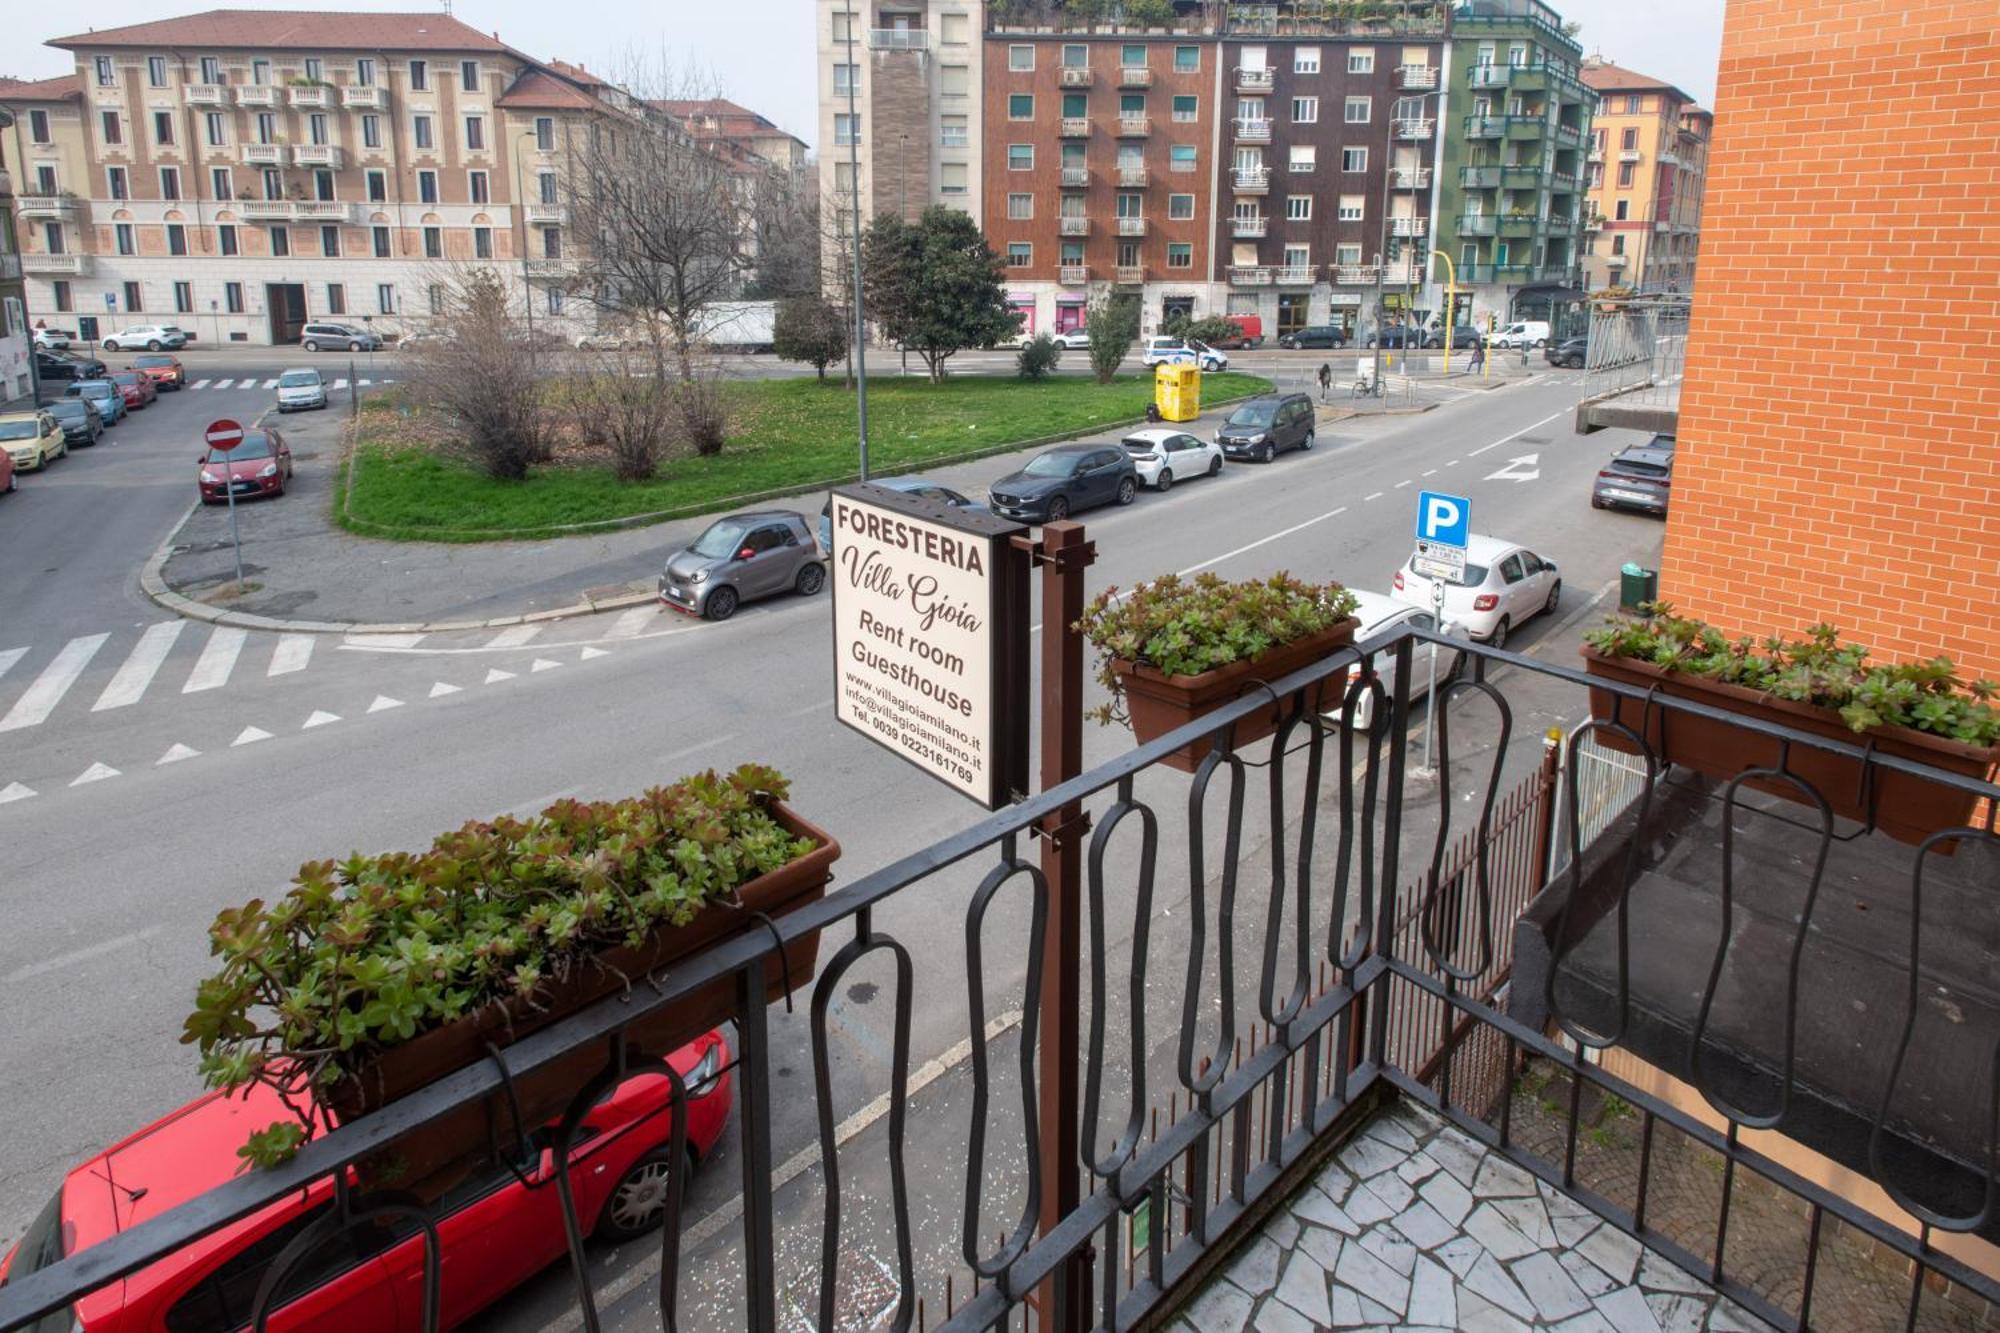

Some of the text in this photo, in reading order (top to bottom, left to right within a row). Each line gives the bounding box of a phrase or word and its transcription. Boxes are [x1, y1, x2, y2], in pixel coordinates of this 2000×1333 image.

[838, 504, 984, 576] FORESTERIA
[1426, 497, 1459, 537] P
[842, 545, 982, 632] Villa Gioia
[852, 641, 973, 717] Guesthouse
[859, 609, 964, 676] Rent room
[845, 685, 982, 771] info@villagioiamilano.it
[846, 671, 981, 751] www.villagioiamilano.it
[852, 705, 973, 784] Tel. 0039 0223161769
